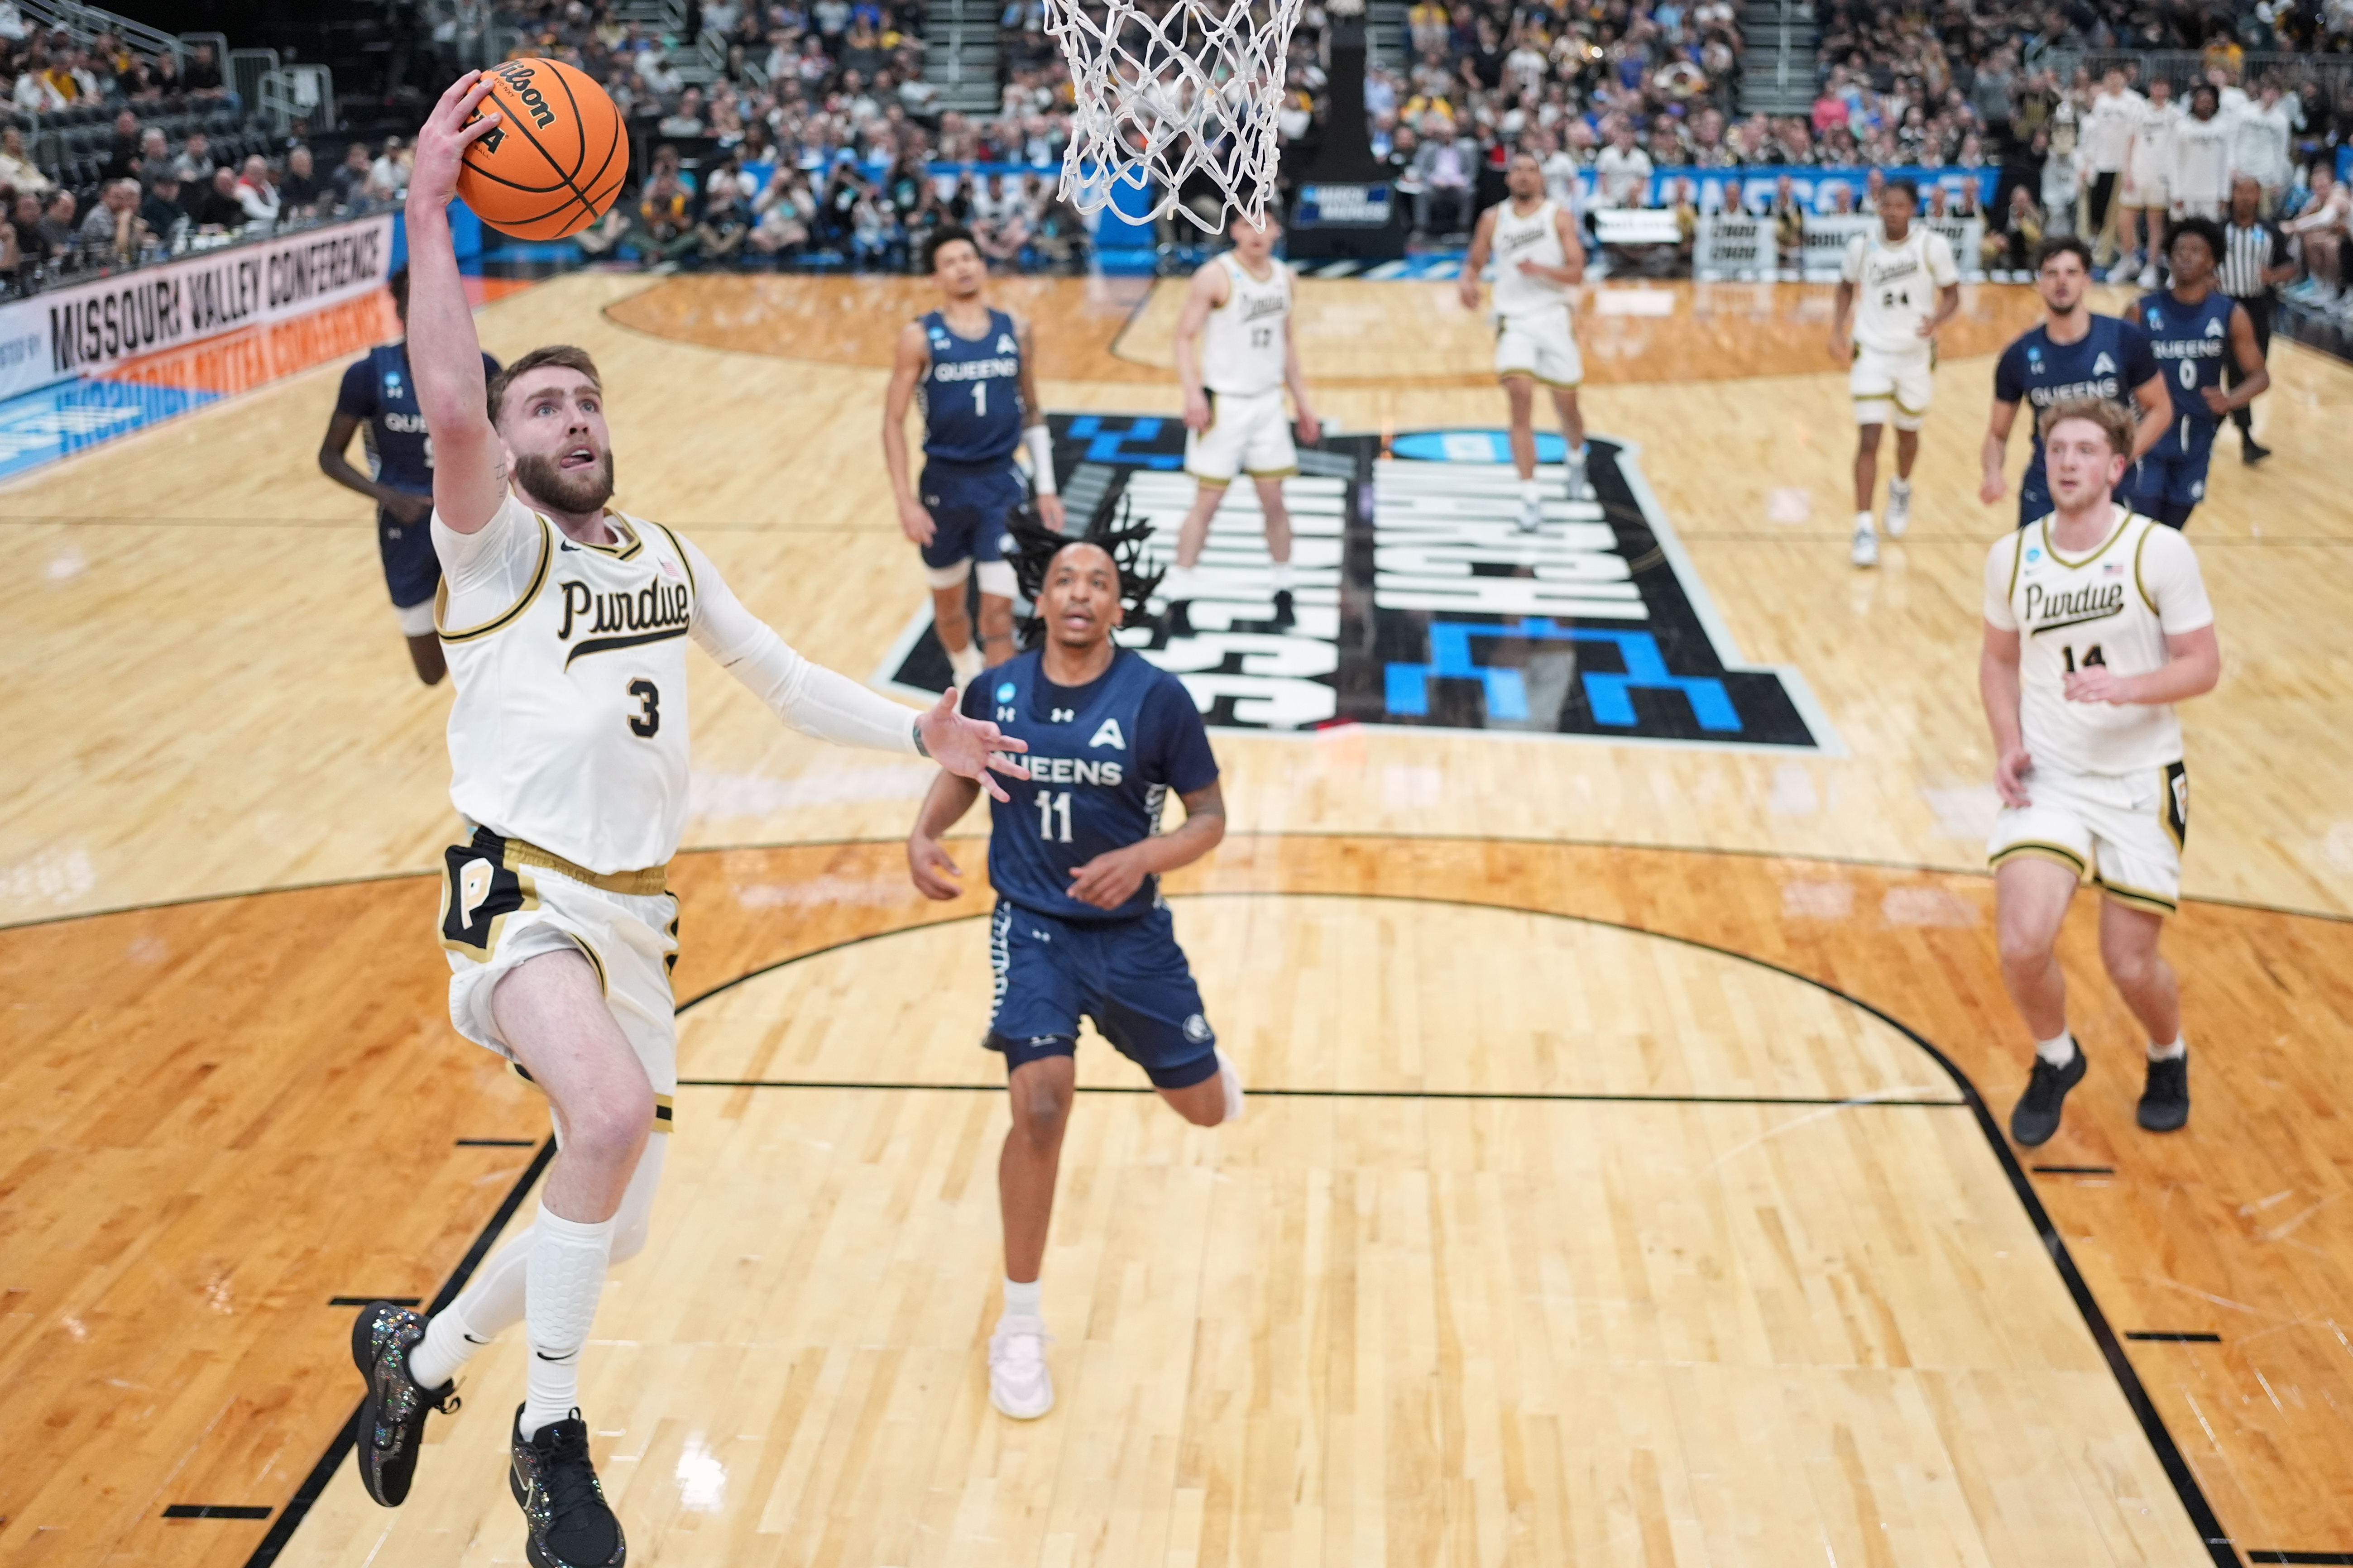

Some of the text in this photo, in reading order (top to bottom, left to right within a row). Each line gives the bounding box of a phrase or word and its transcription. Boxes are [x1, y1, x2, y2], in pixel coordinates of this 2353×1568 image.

[494, 77, 515, 98] EVO NXT
[50, 278, 181, 372] MISSOURI
[187, 258, 262, 329] VALLEY
[268, 227, 380, 311] CONFERENCE
[2151, 339, 2223, 359] QUEENS
[934, 357, 1018, 382] QUEENS
[2179, 359, 2198, 391] 0
[969, 380, 987, 417] 1
[2031, 377, 2118, 407] QUEENS
[1372, 458, 1650, 621] MARCH
[557, 574, 690, 640] Purdue
[2026, 581, 2124, 621] Purdue
[2062, 643, 2106, 673] 14
[626, 677, 660, 739] 3
[1034, 790, 1072, 844] 11
